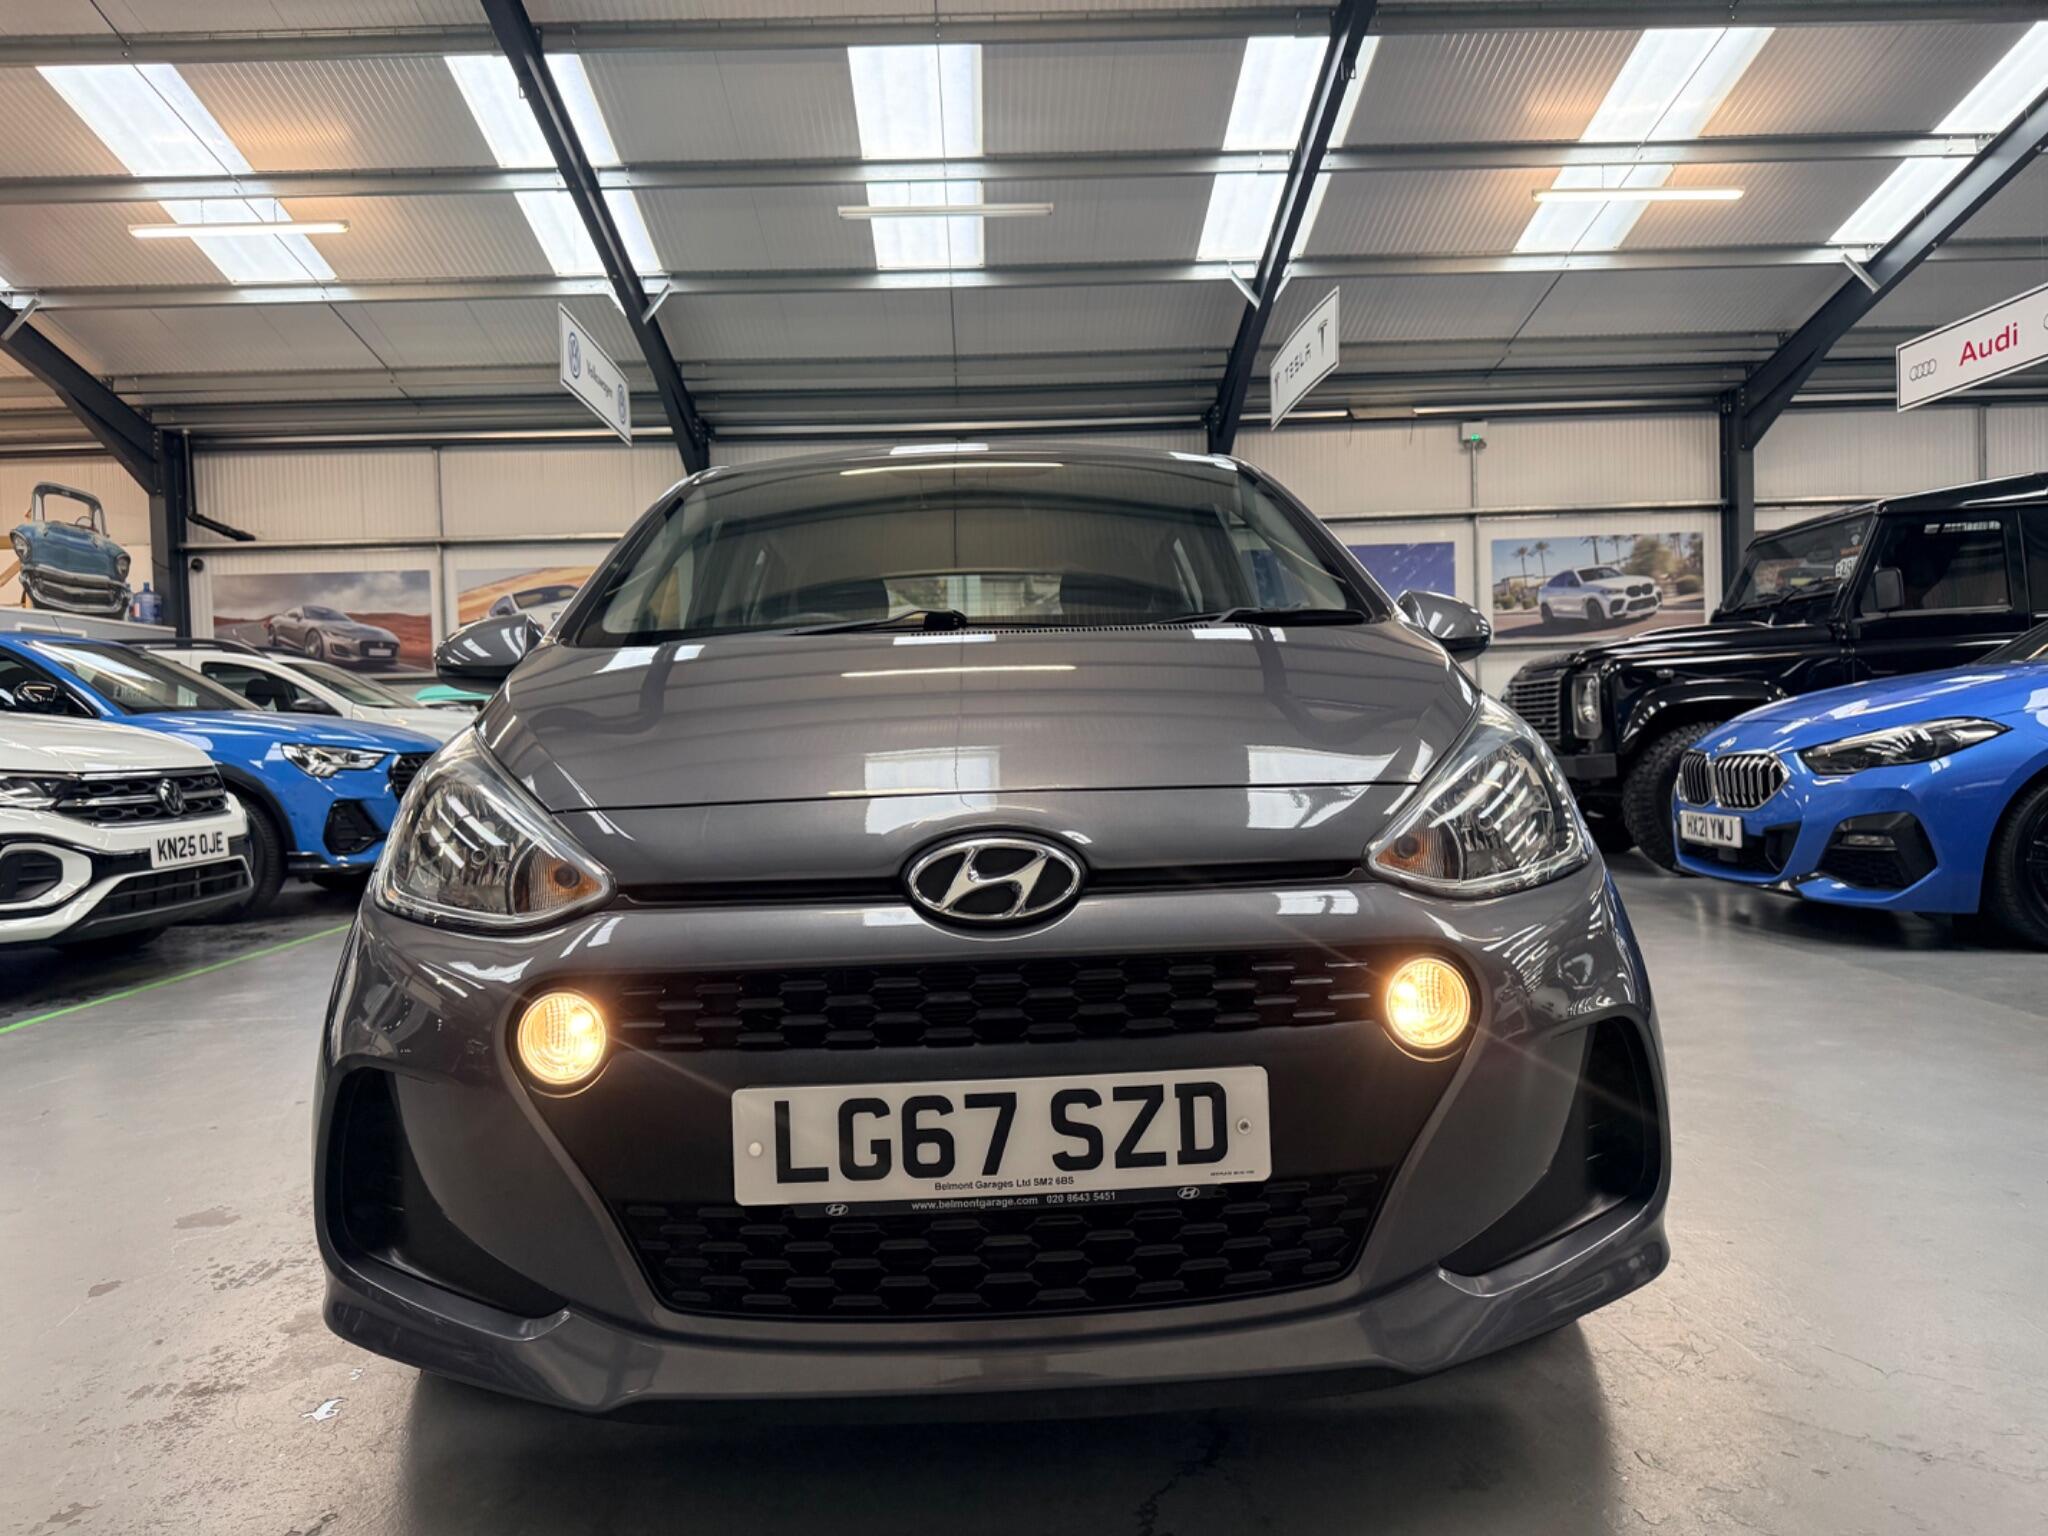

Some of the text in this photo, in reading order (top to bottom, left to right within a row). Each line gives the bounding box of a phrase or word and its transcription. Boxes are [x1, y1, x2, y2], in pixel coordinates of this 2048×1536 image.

[1959, 322, 2018, 367] Audi
[1710, 818, 1733, 841] YWJ
[157, 831, 224, 861] KN25 OJE
[774, 1081, 1228, 1184] LG67 SZD
[934, 1182, 973, 1191] Belmont
[975, 1179, 1013, 1190] Garages
[1016, 1178, 1030, 1188] Ltd
[1033, 1177, 1053, 1187] SM2
[911, 1192, 1116, 1211] www.belmontgarage.com 020 8643 5451
